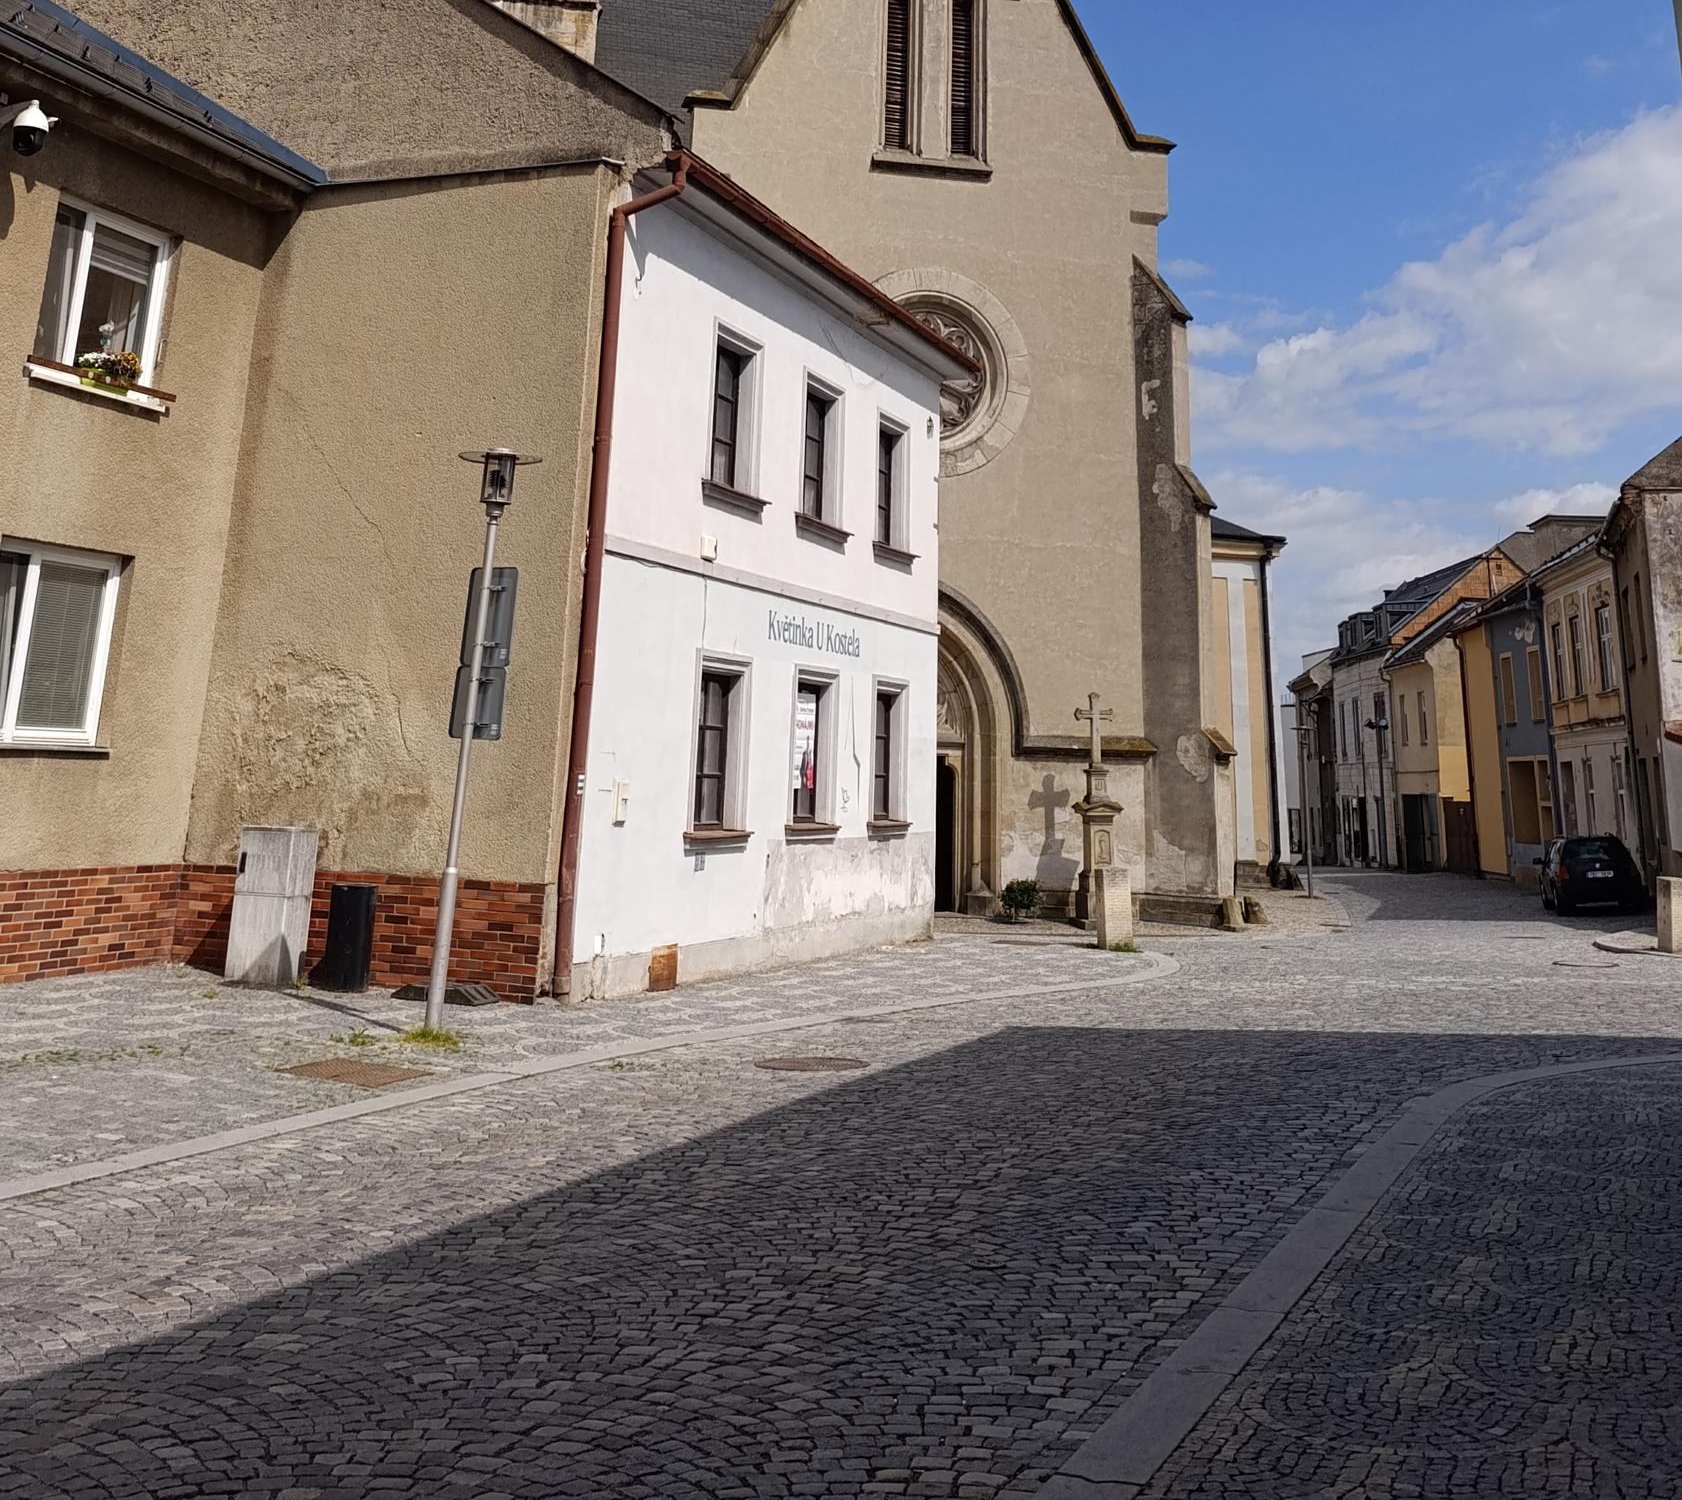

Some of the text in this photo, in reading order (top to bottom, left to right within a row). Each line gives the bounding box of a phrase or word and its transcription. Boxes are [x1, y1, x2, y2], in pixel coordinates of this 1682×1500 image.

[768, 610, 860, 658] Květinka U Kostela
